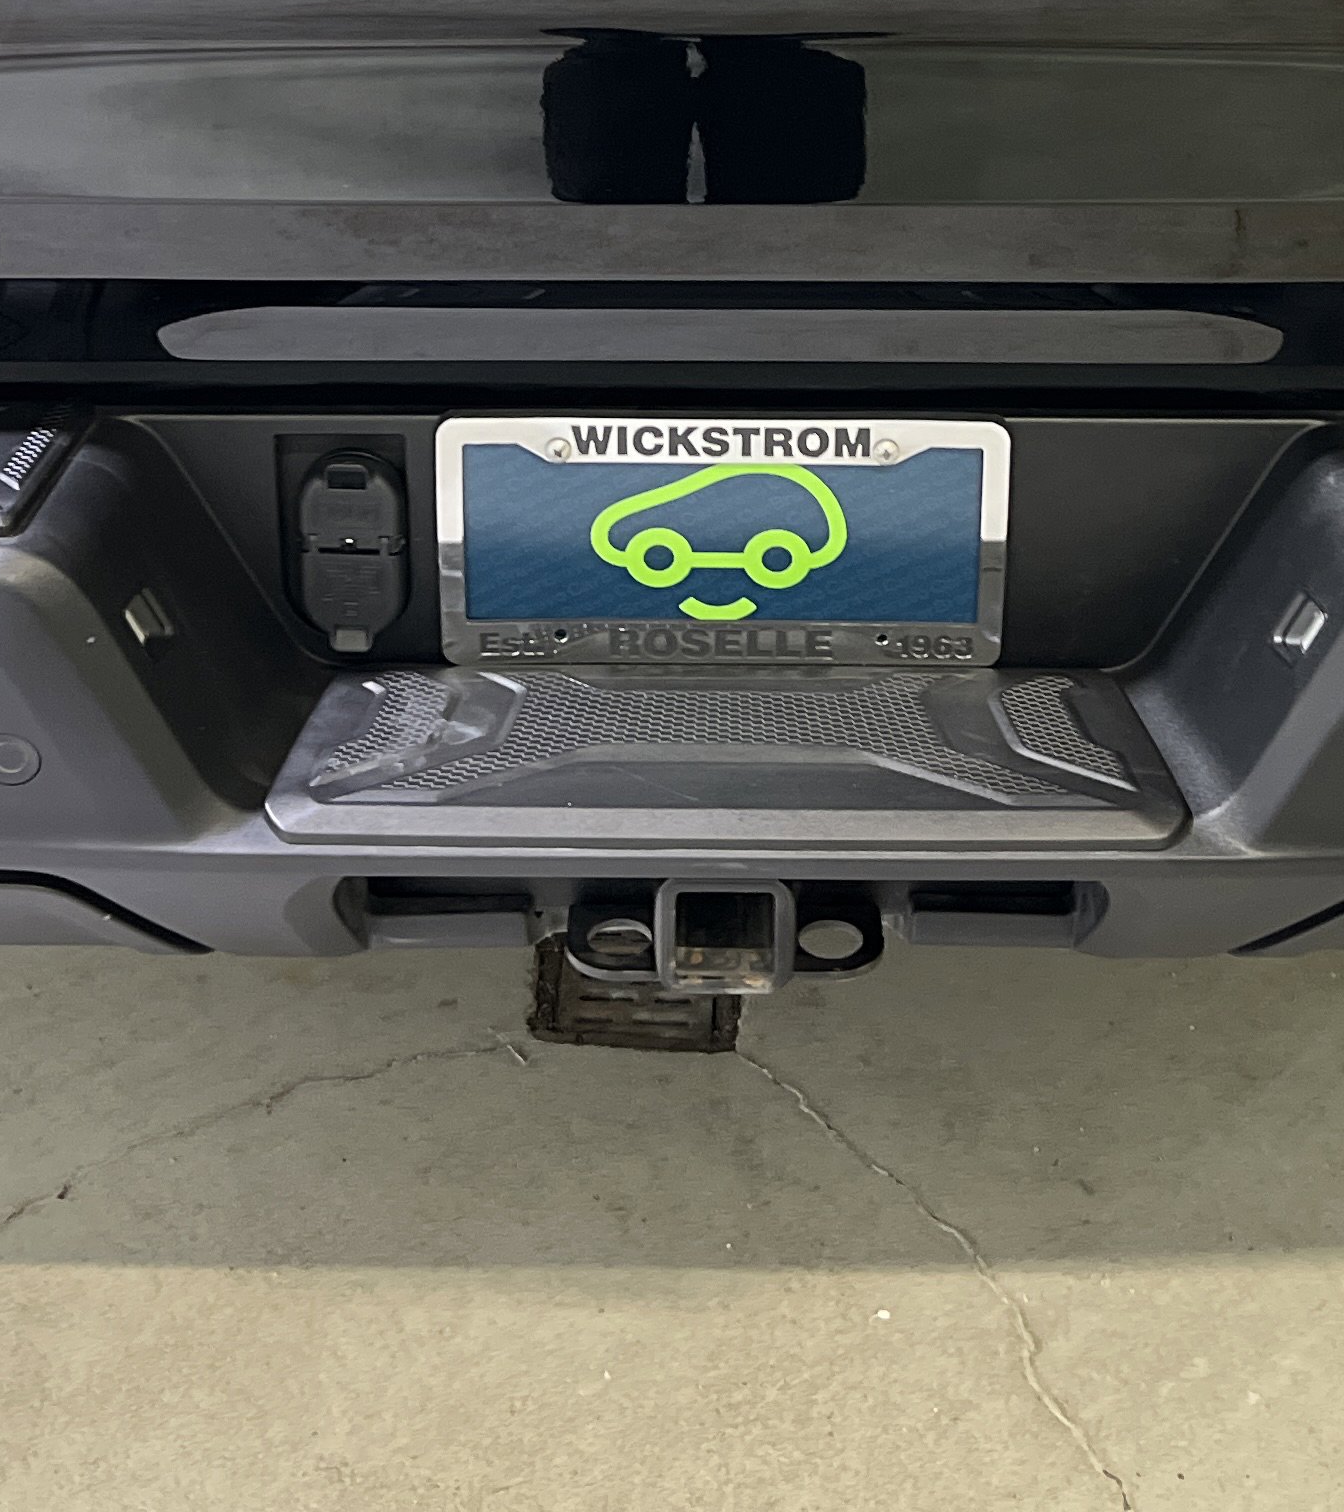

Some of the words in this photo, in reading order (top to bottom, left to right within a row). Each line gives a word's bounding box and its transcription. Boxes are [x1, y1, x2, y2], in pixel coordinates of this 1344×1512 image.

[572, 425, 871, 458] WICKSTROM
[608, 628, 834, 660] ROSELLE
[894, 635, 974, 659] 1963
